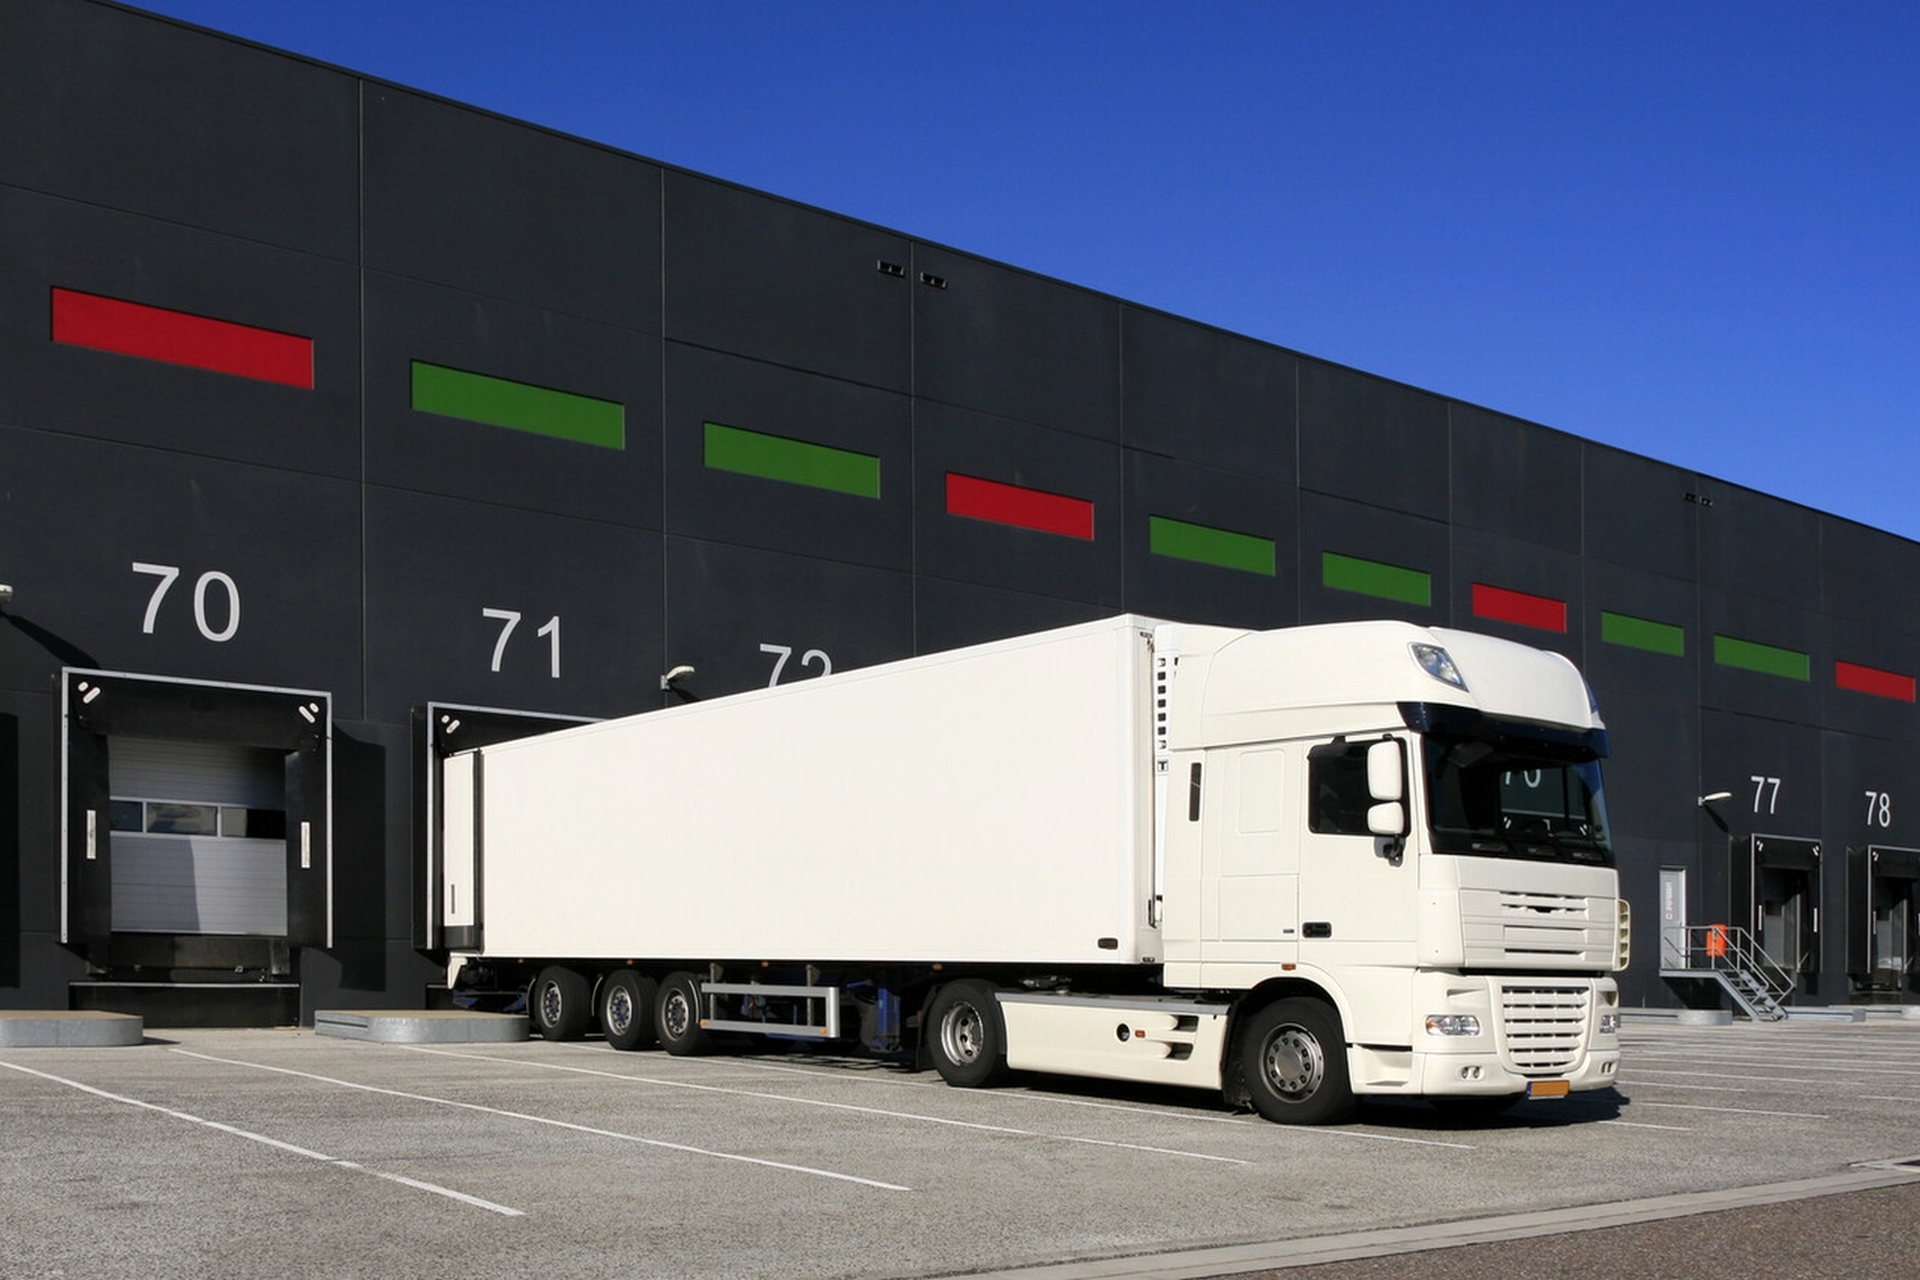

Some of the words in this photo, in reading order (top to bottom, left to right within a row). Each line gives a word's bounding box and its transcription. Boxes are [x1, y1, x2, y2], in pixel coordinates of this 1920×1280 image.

[131, 562, 241, 643] 70
[482, 607, 561, 679] 71
[1751, 775, 1781, 815] 77
[1865, 790, 1891, 828] 78
